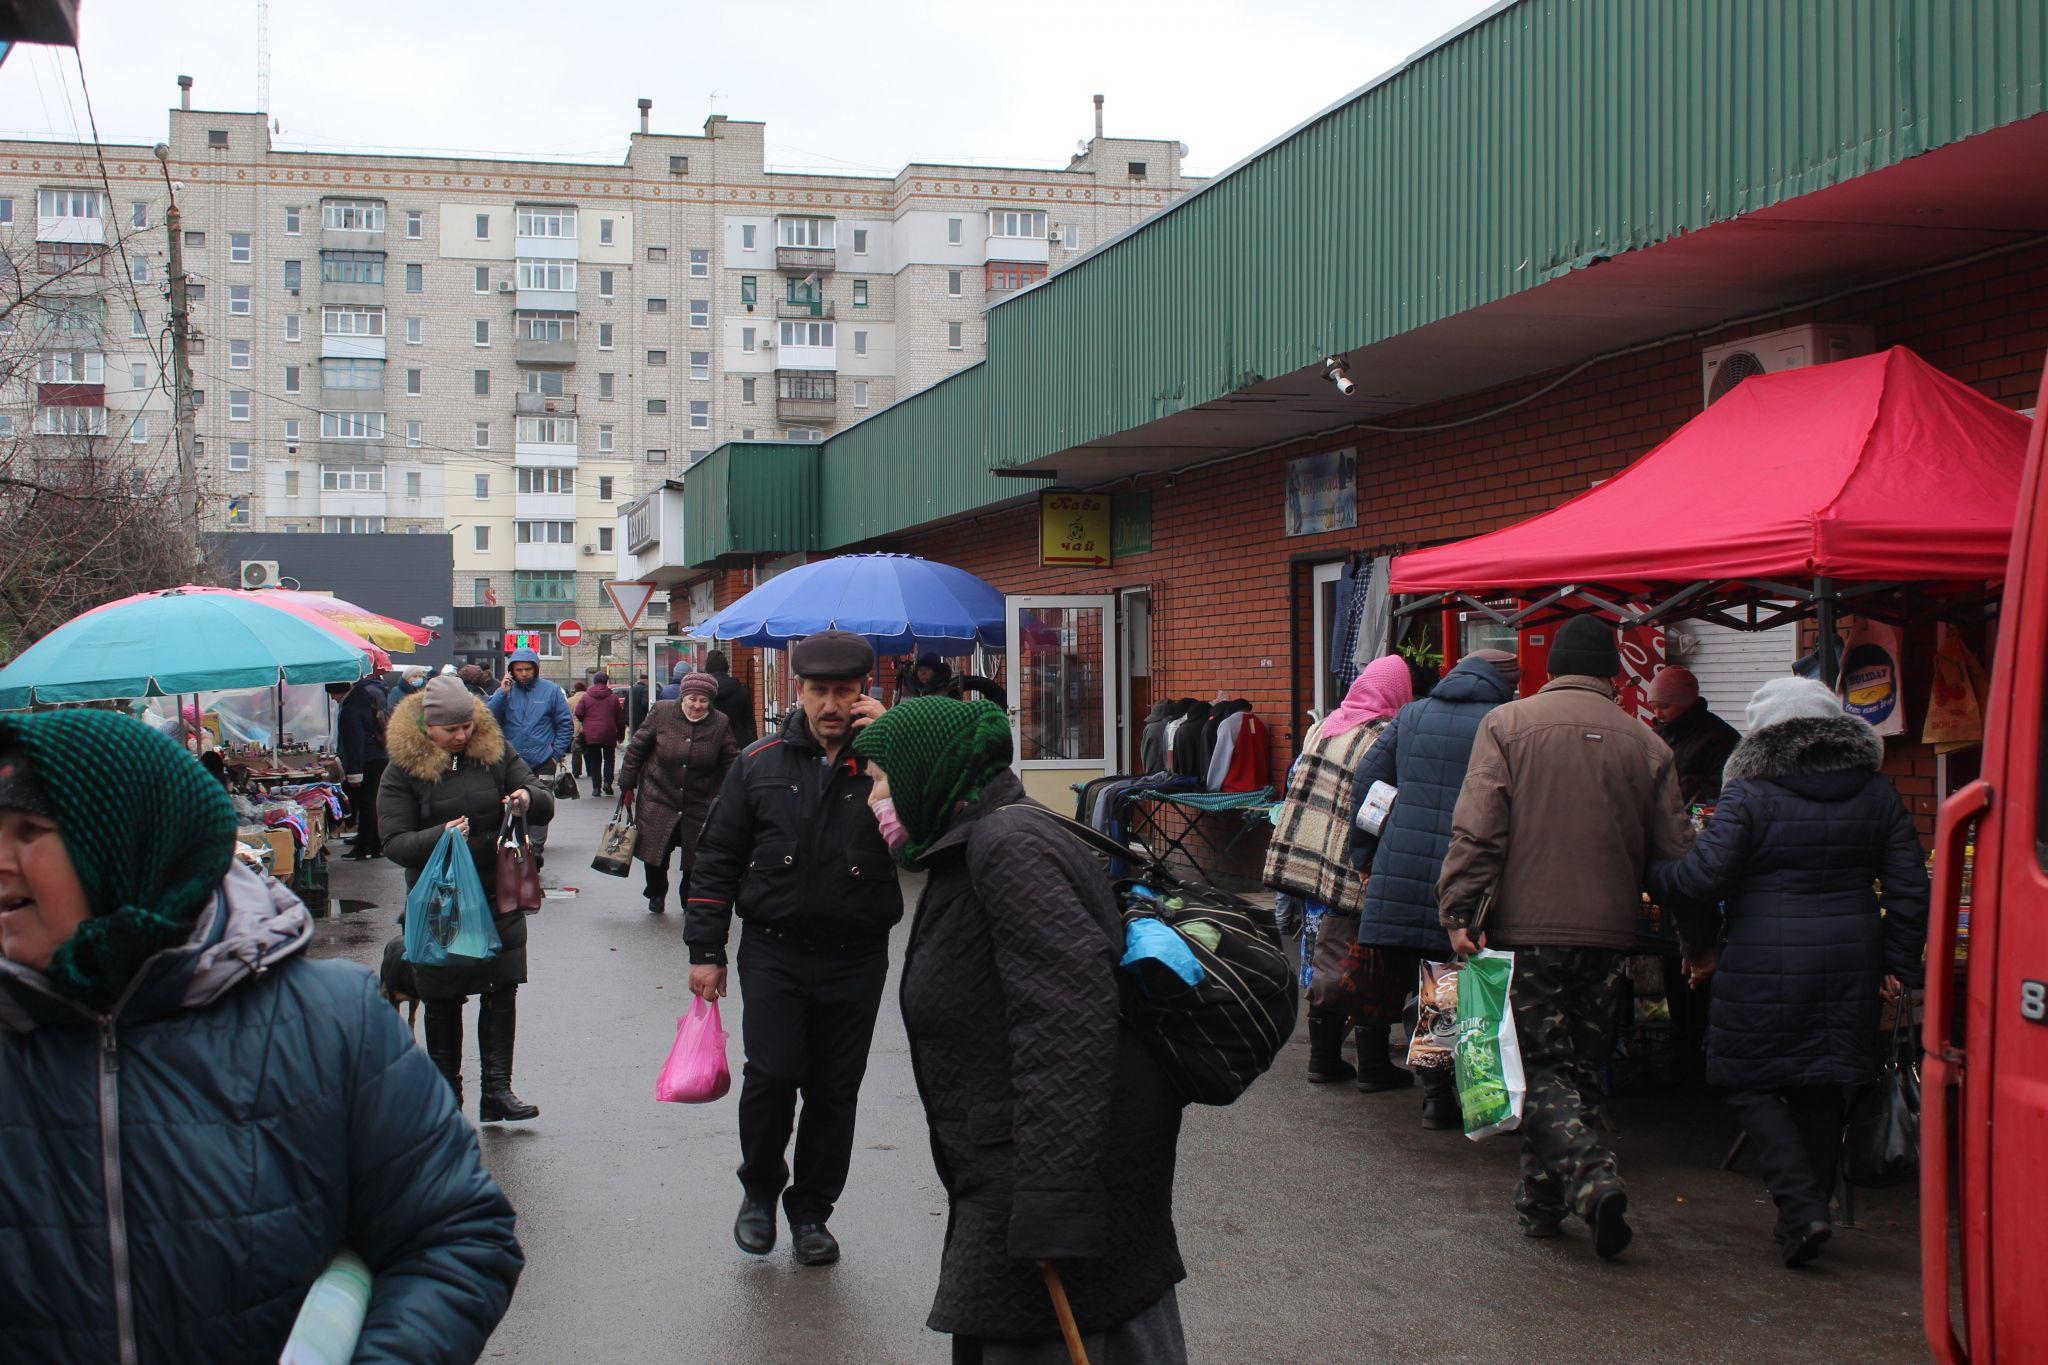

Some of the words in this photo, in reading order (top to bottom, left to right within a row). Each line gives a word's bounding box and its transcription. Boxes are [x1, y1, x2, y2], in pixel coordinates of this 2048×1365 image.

[1050, 497, 1101, 511] Кава
[629, 504, 650, 548] ВЗУТТЯ
[1060, 541, 1095, 552] чай
